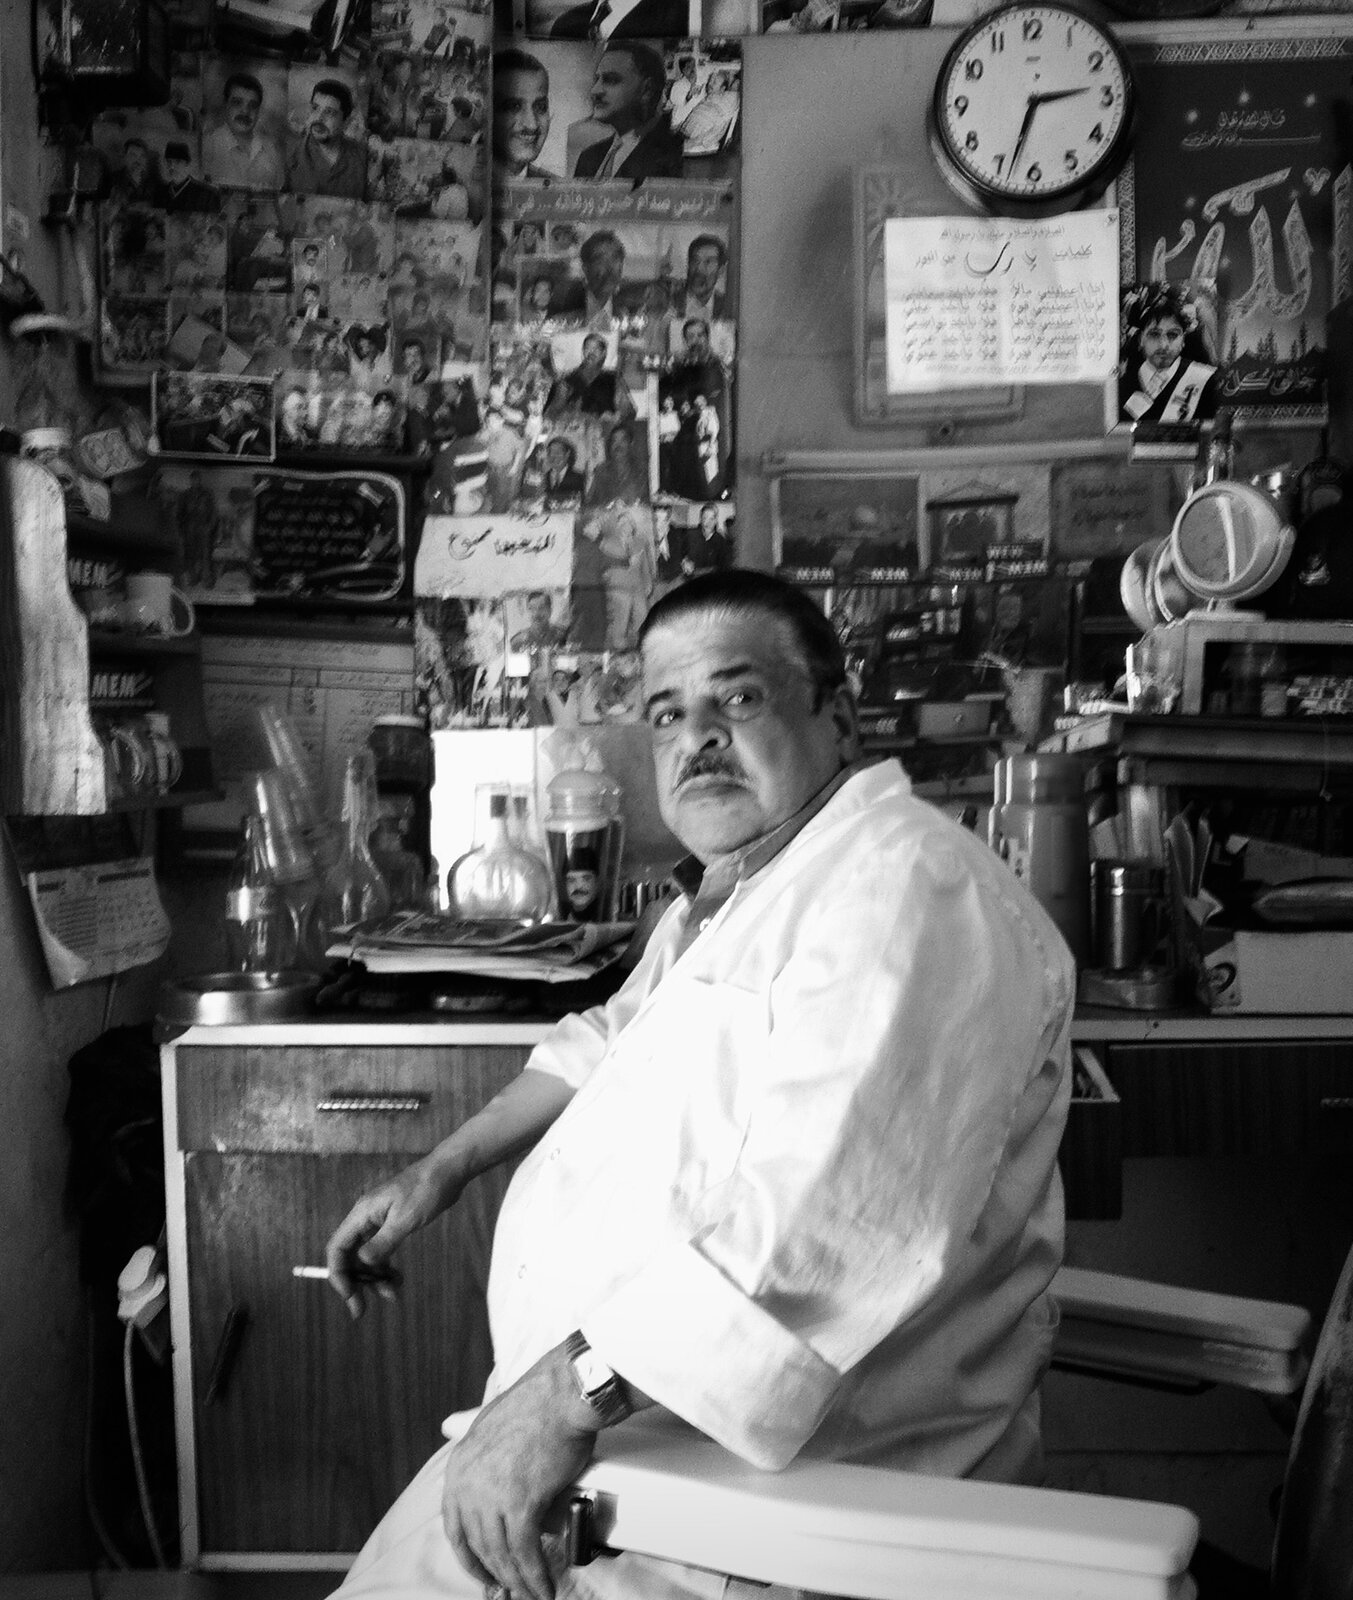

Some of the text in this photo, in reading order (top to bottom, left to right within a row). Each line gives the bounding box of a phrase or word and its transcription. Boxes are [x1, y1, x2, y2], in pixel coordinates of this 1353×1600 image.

[1022, 18, 1043, 41] 12
[1067, 25, 1073, 48] 1
[991, 31, 1005, 53] 11
[965, 58, 984, 81] 10
[1087, 50, 1104, 73] 2
[954, 95, 969, 118] 9
[1101, 85, 1114, 109] 3
[965, 130, 979, 151] 8
[1088, 122, 1104, 144] 4
[993, 153, 1006, 175] 7
[1026, 162, 1042, 182] 6
[1064, 150, 1079, 172] 5
